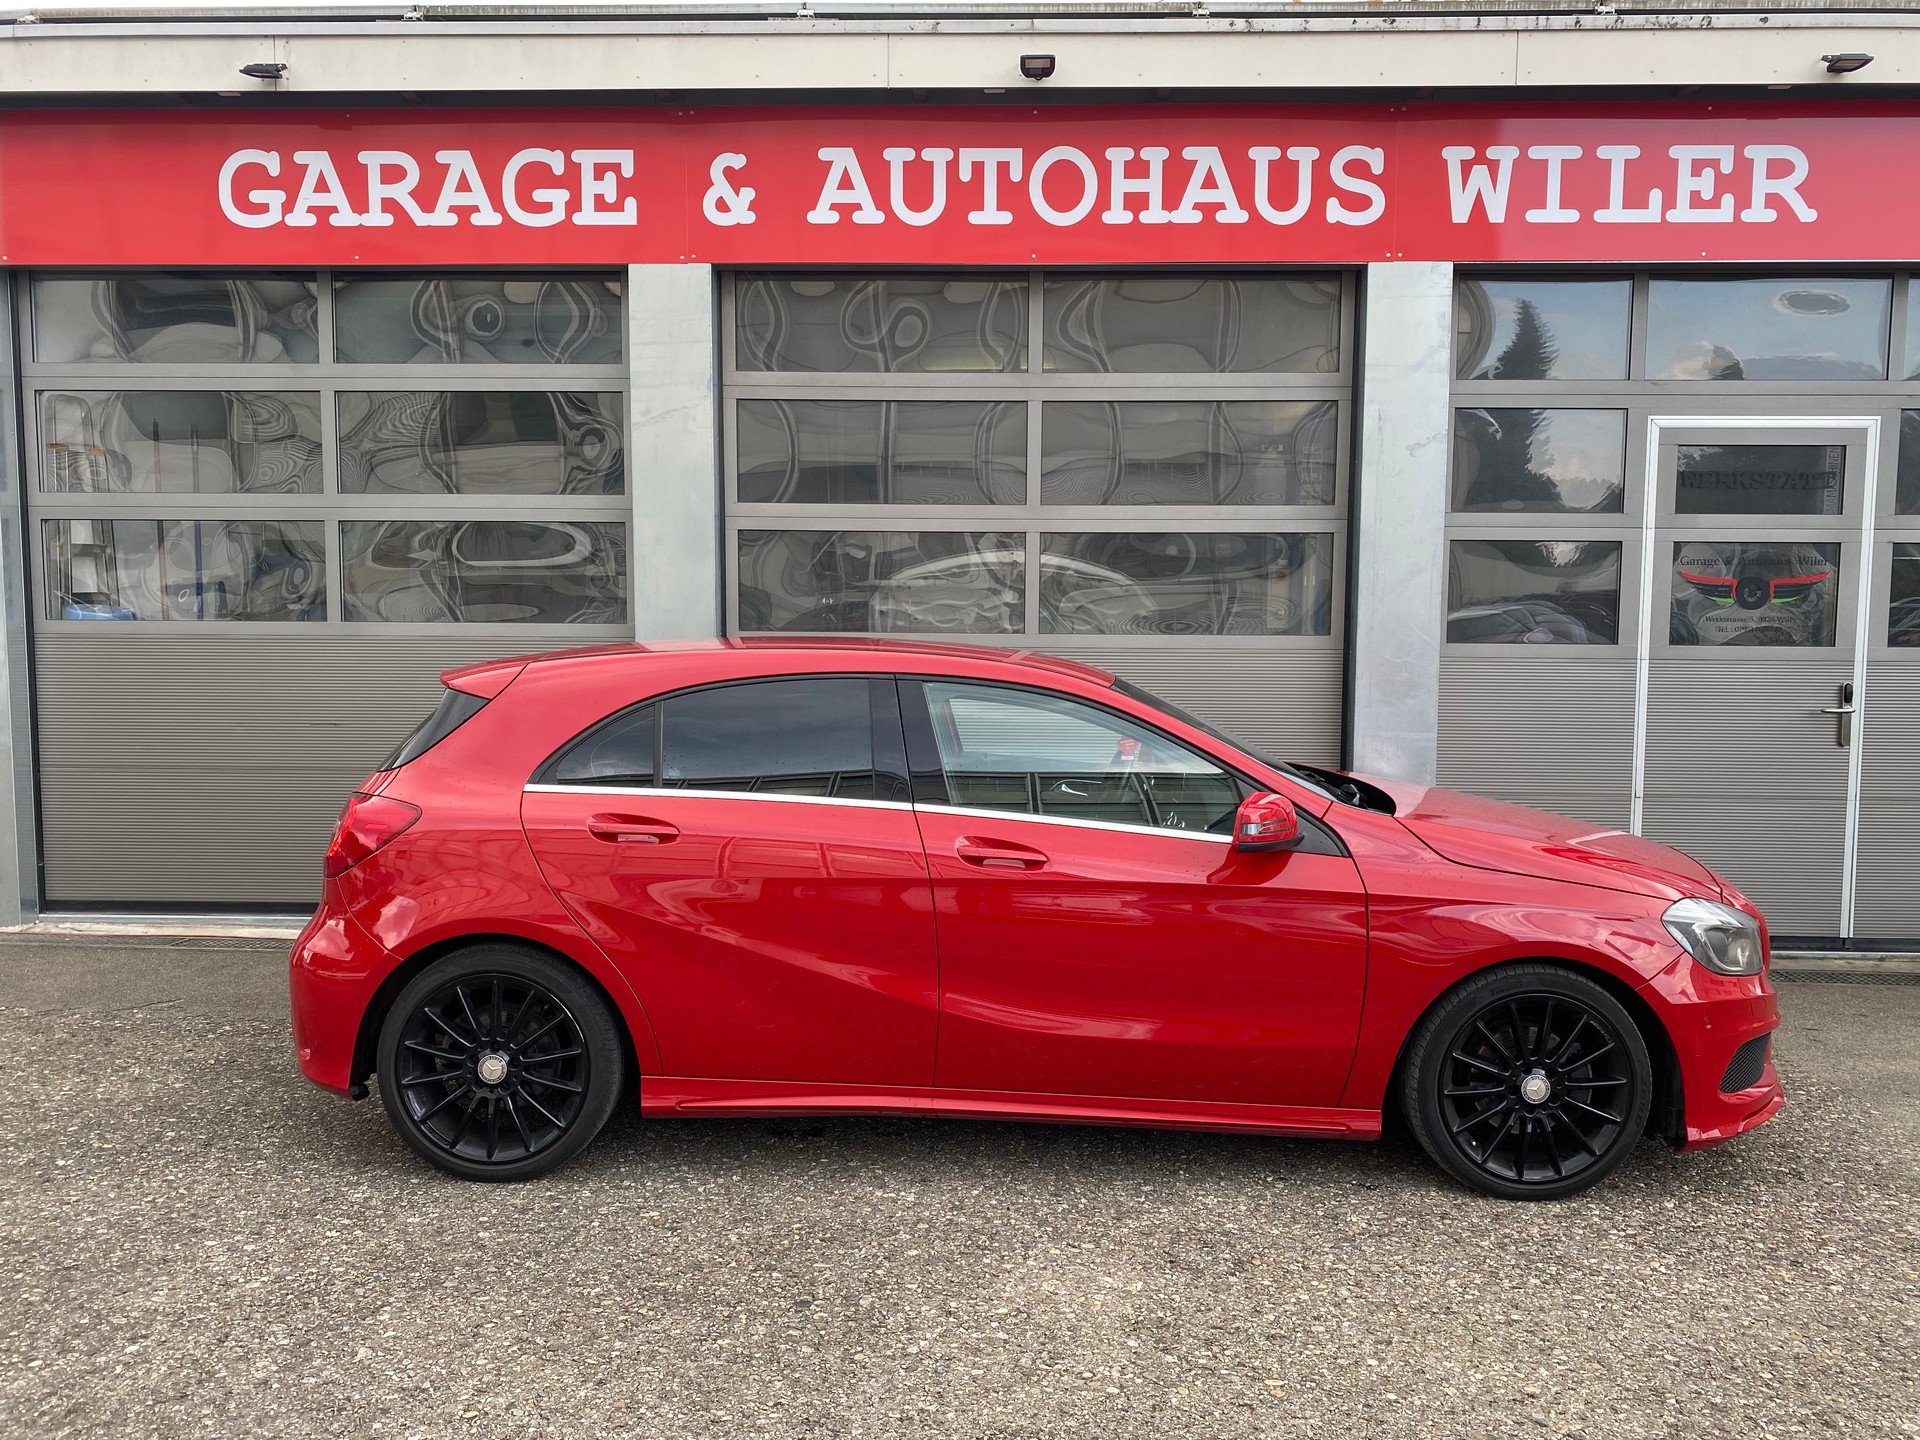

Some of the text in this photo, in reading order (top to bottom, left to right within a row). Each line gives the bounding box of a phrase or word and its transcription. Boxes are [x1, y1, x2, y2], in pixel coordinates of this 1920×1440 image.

[218, 144, 1819, 229] GARAGE & AUTOHAUS WILER
[1679, 555, 1720, 569] Garage
[1799, 555, 1828, 567] Wiler
